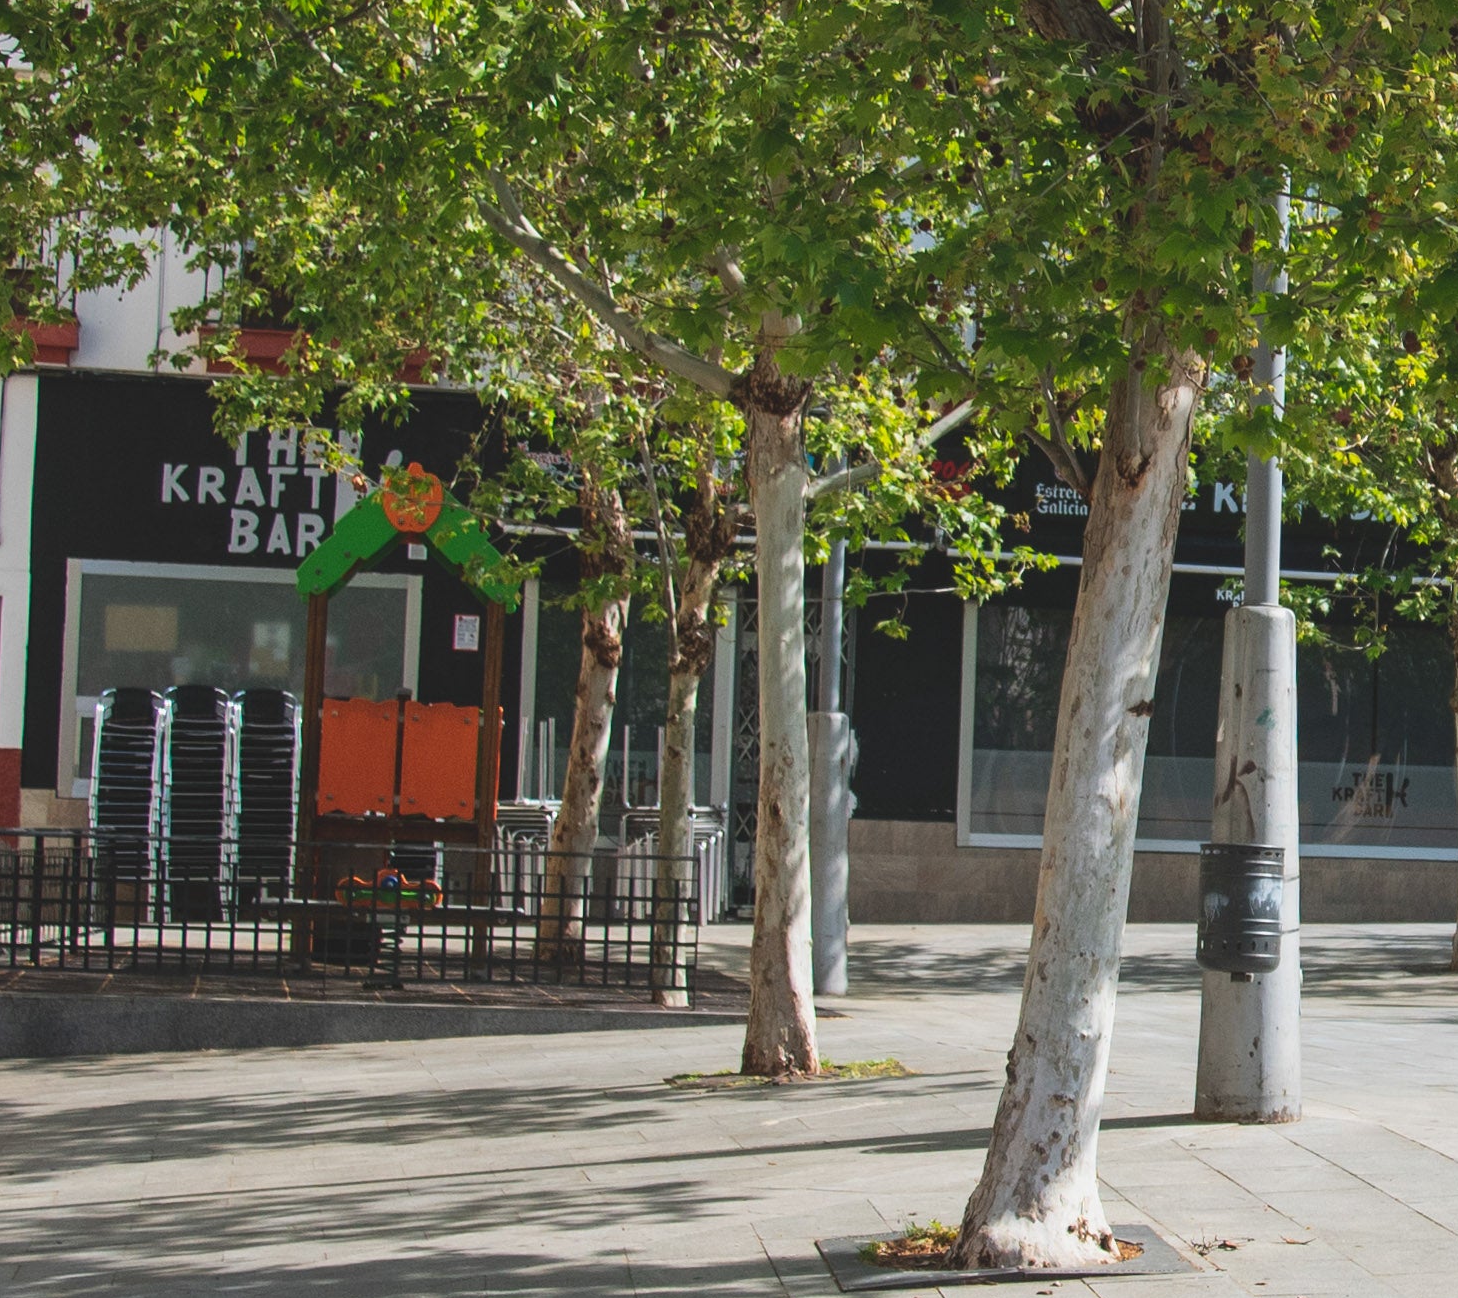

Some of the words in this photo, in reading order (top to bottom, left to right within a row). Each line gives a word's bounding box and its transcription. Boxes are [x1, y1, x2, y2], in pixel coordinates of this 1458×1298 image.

[161, 463, 330, 509] KRAFT
[1034, 483, 1083, 500] Estrel
[1036, 499, 1089, 516] Galicia
[228, 508, 326, 557] BAR
